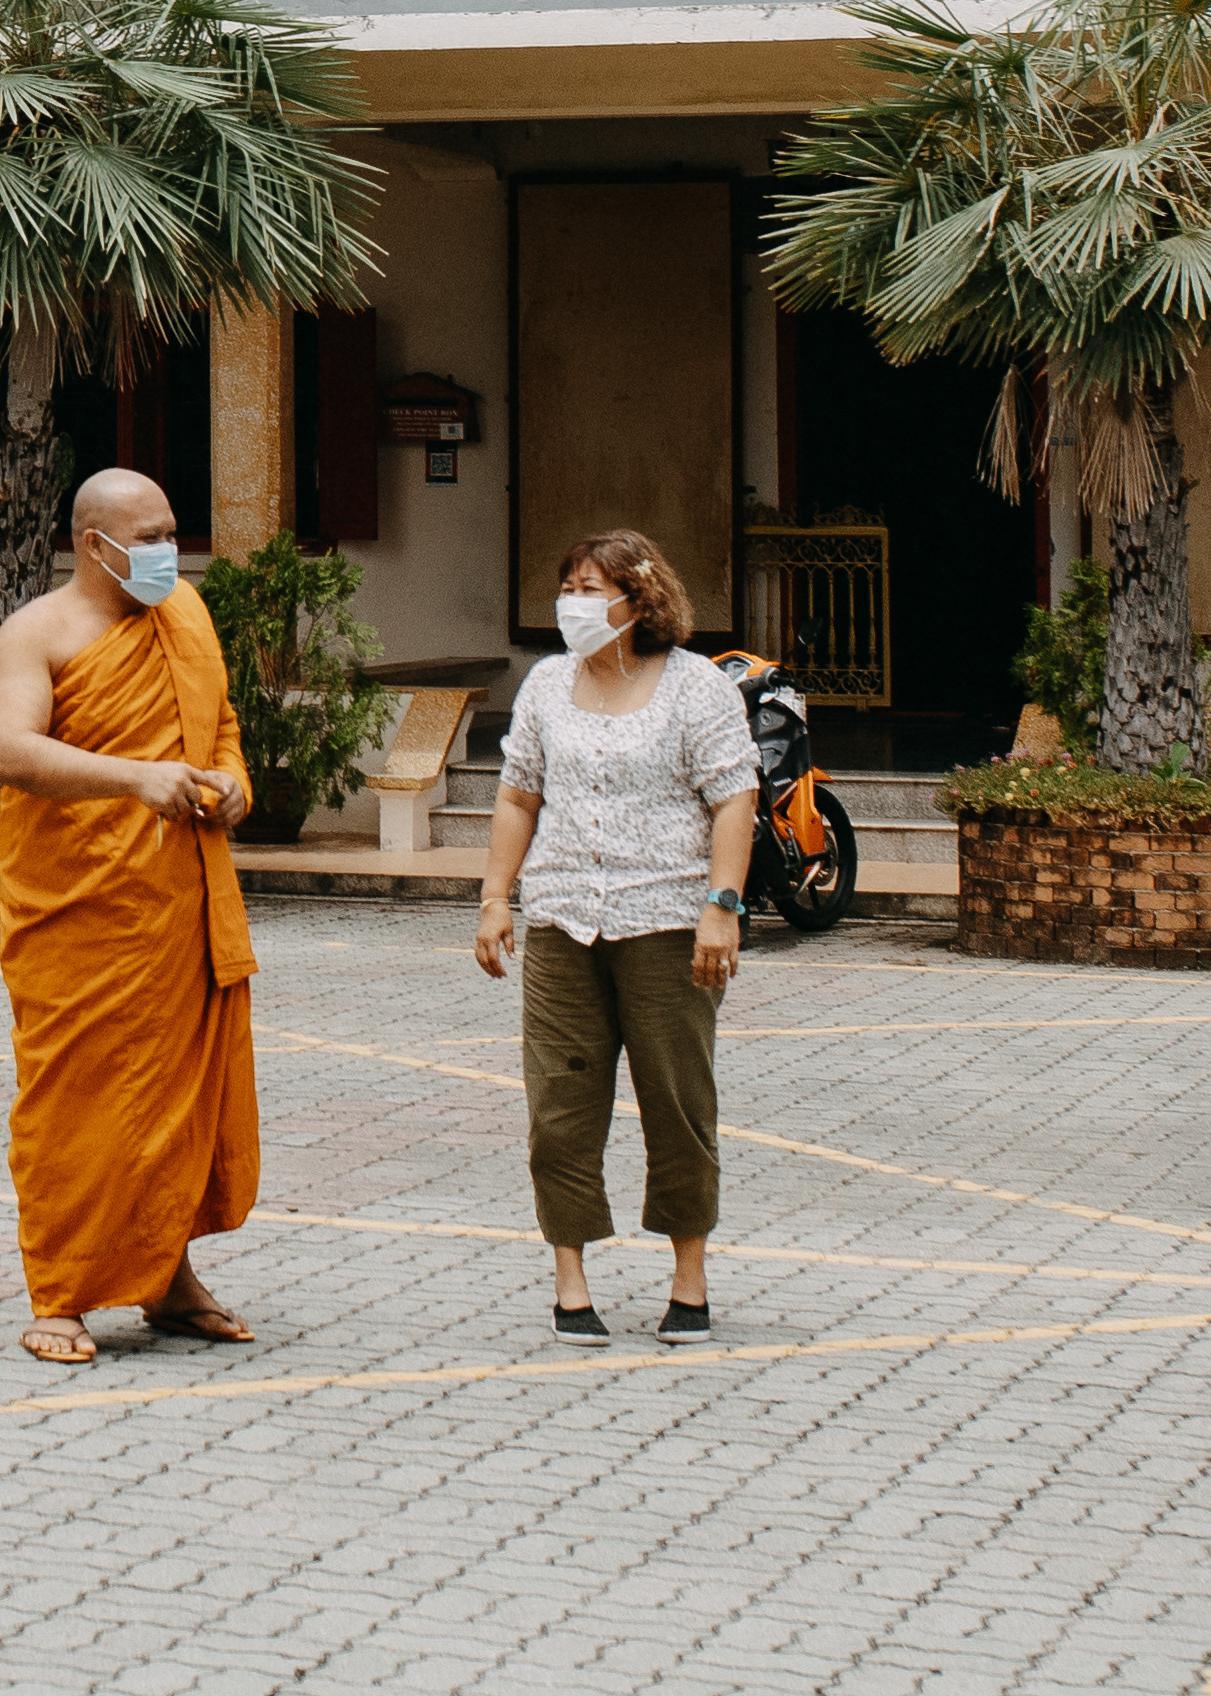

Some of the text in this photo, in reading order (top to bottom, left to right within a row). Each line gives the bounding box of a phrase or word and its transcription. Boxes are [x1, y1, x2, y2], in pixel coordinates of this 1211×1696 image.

[383, 408, 459, 416] CHECK POINT BOX
